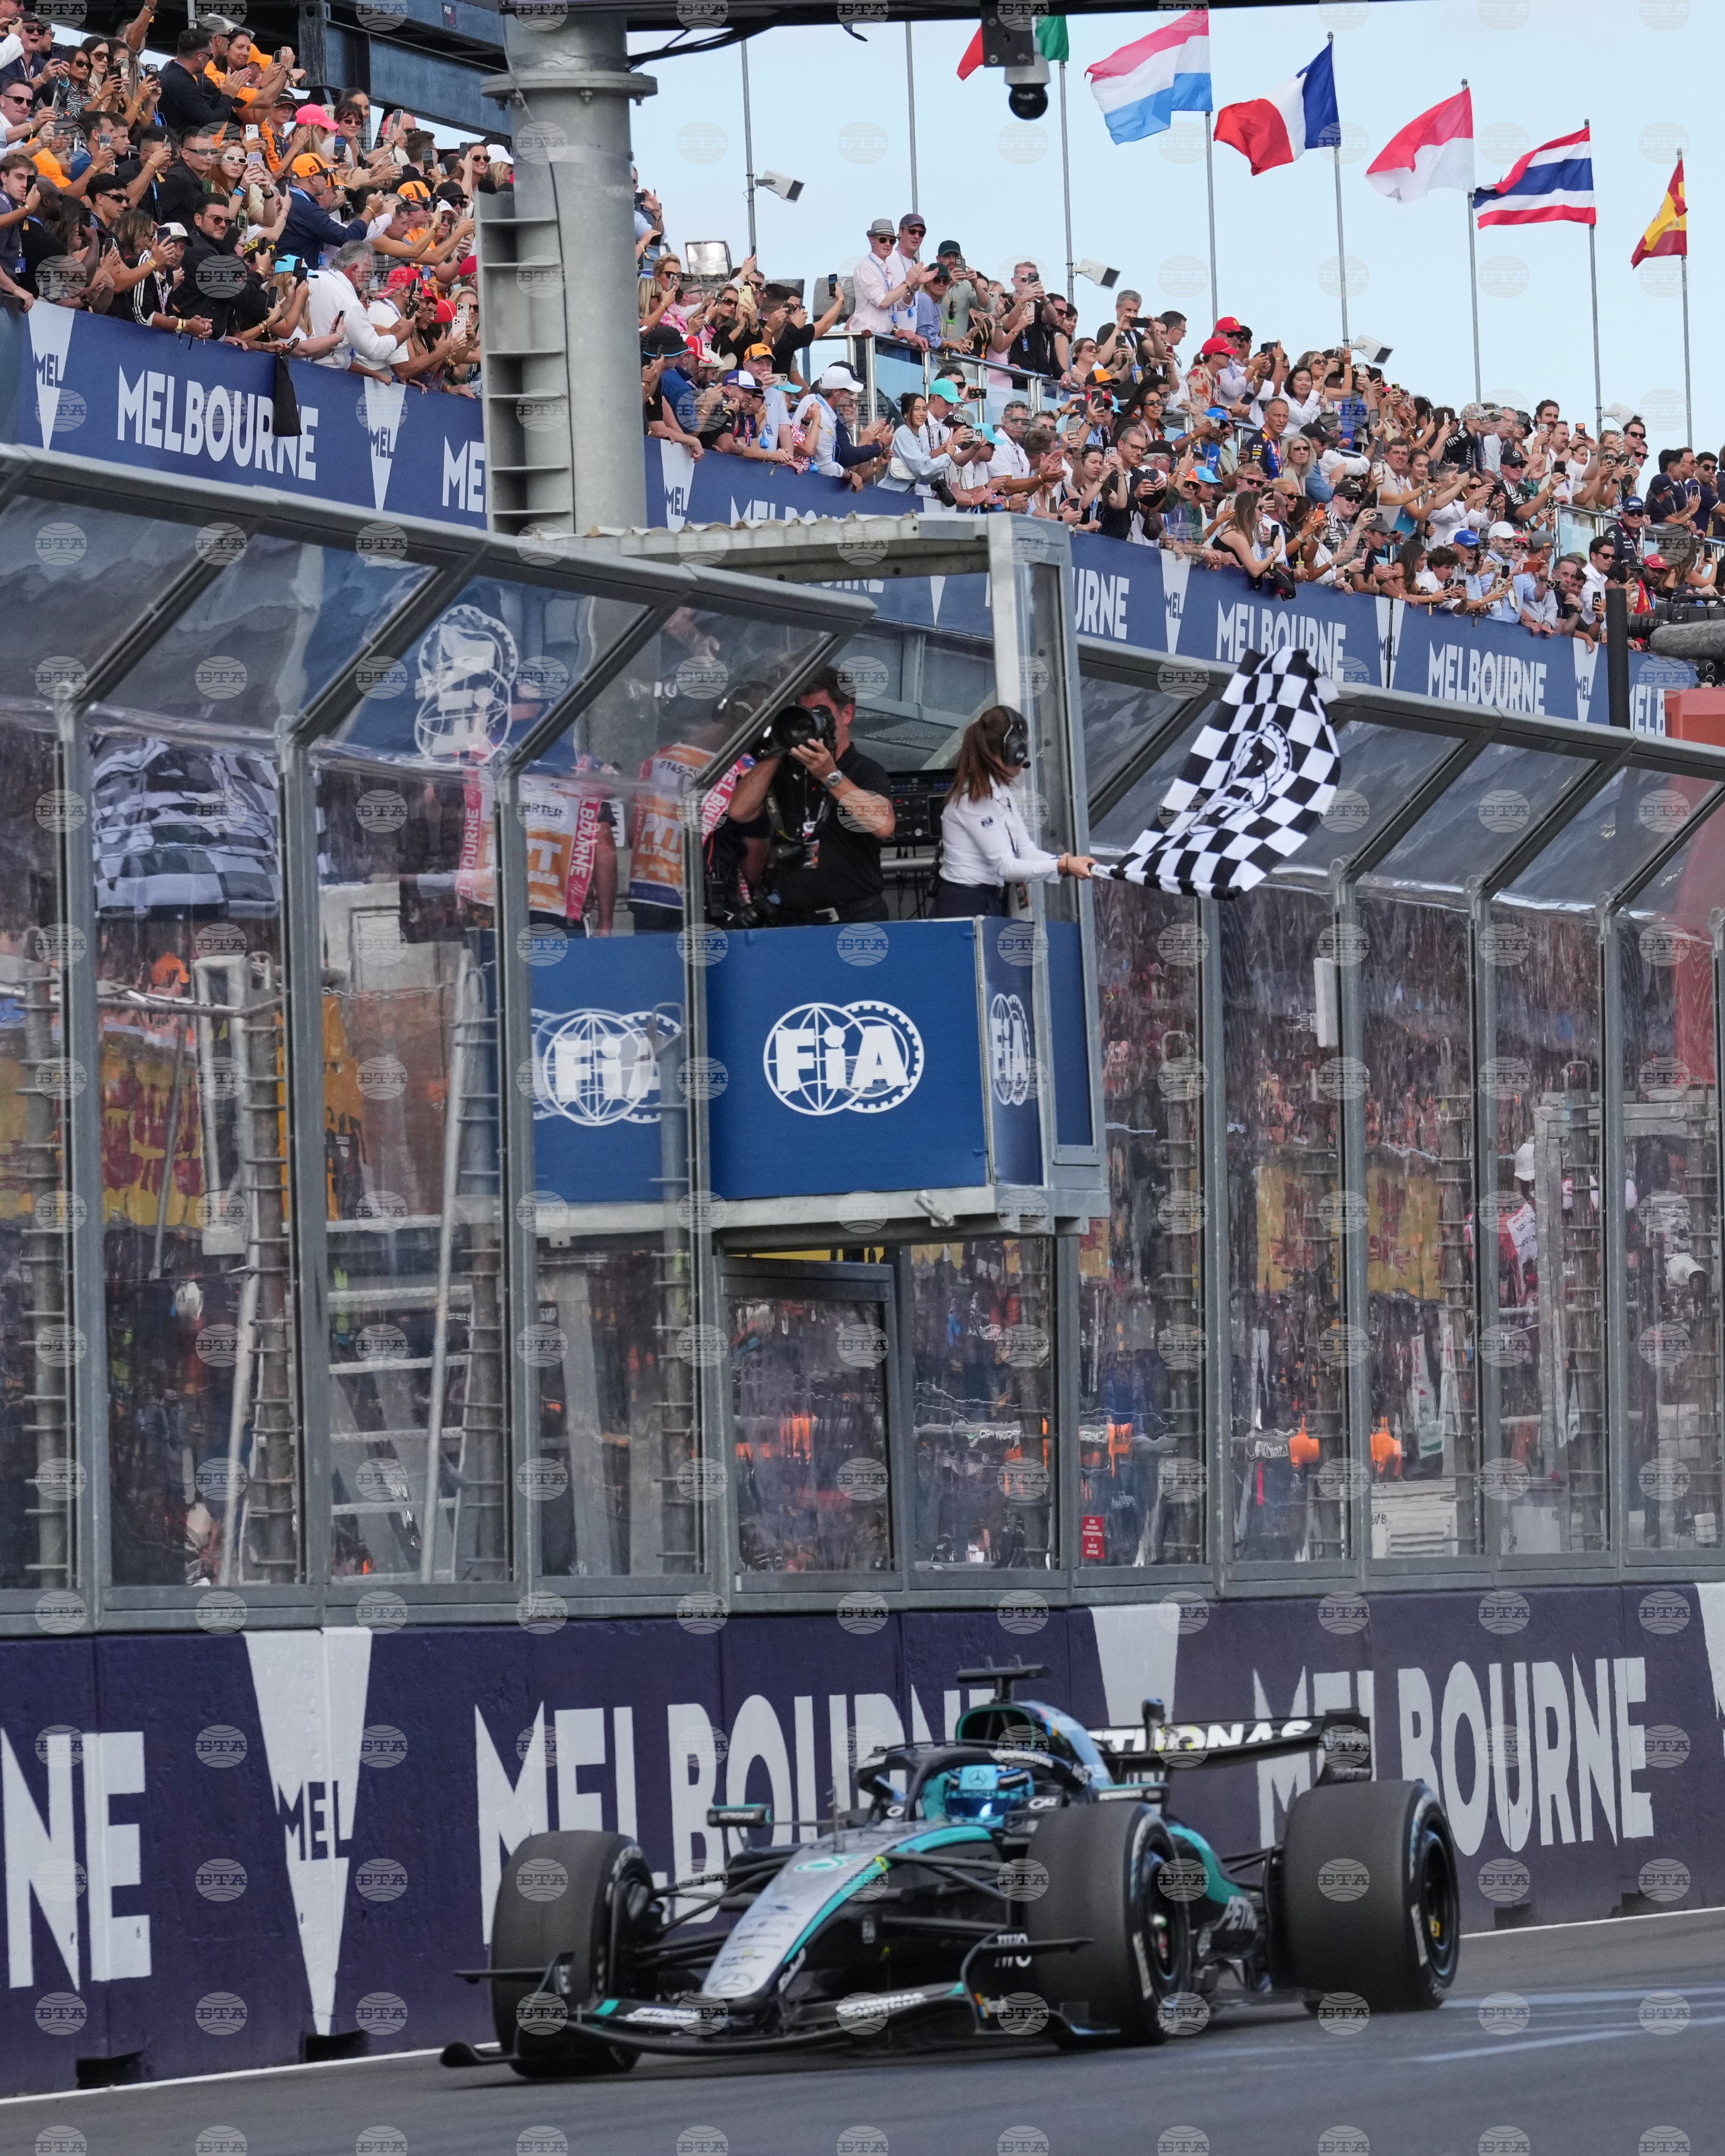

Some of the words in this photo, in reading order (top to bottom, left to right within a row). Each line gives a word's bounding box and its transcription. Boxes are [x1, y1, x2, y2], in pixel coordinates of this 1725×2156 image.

[34, 349, 62, 387] MEL
[370, 424, 394, 459] MEL
[665, 485, 687, 516] MEL
[1165, 590, 1183, 619] MEL
[1428, 640, 1546, 715] MELBOURNE
[1576, 674, 1591, 701] MEL
[277, 1780, 353, 1861] MEL
